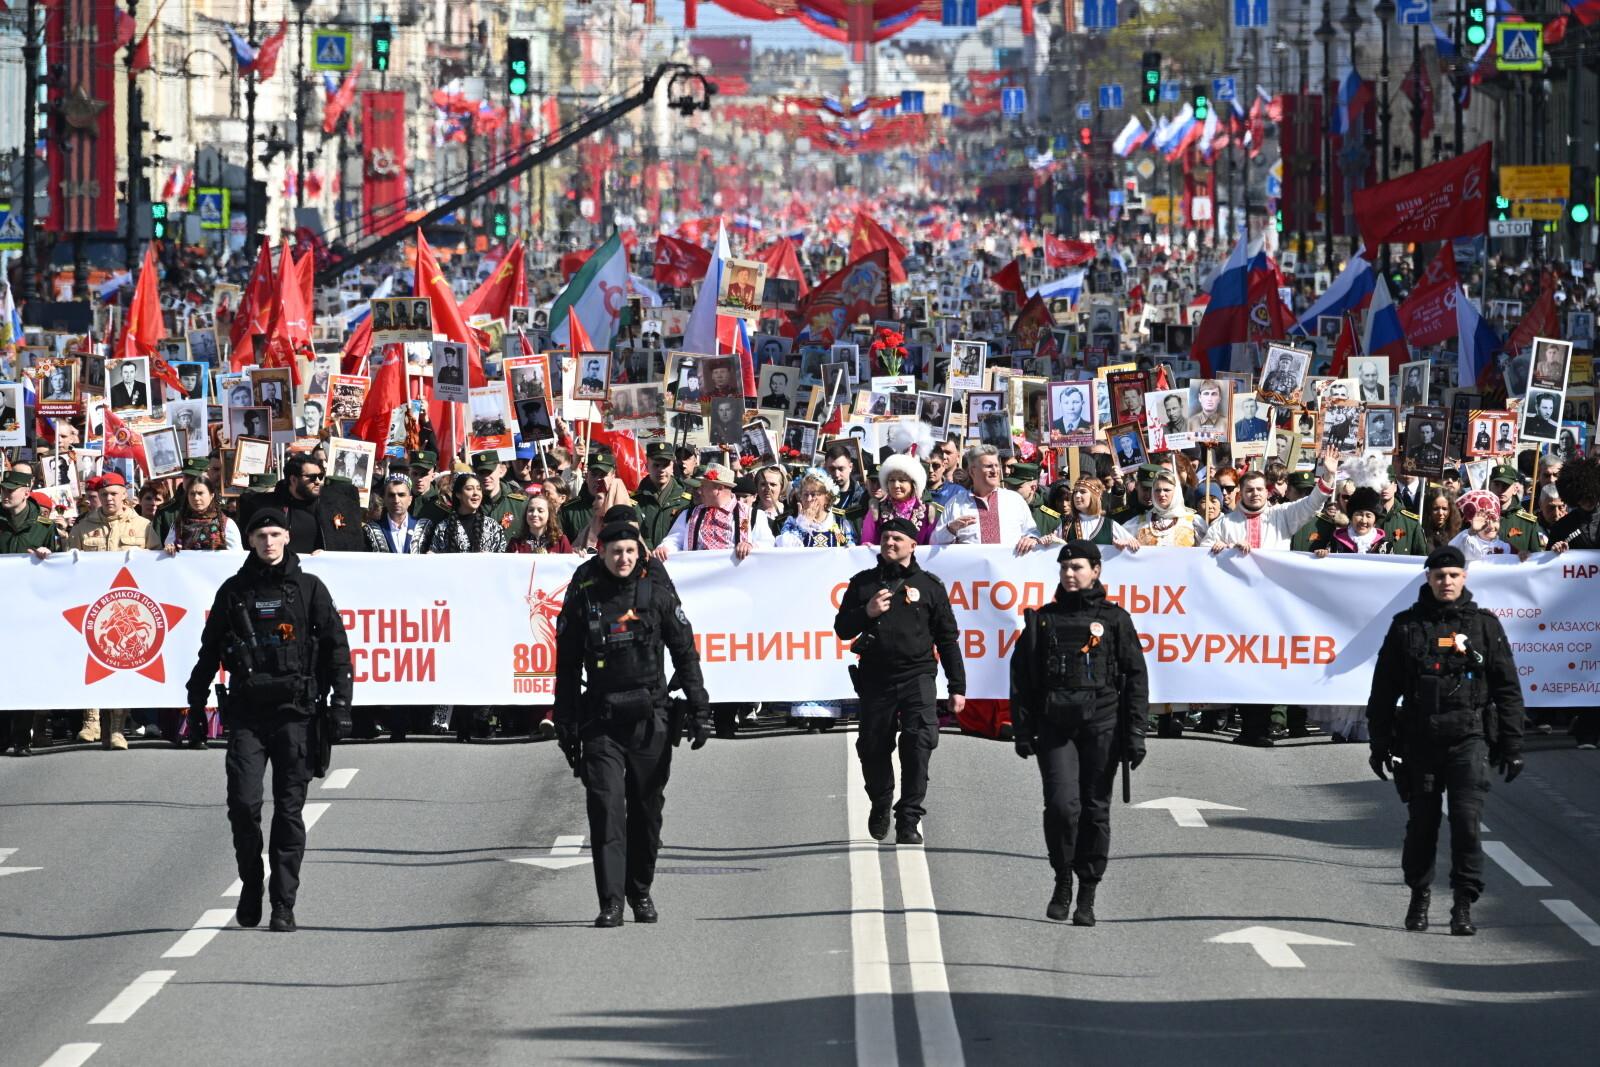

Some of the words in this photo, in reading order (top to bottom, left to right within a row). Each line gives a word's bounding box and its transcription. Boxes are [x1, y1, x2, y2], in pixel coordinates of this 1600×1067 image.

[1496, 223, 1531, 234] СТОП
[1563, 565, 1600, 578] НАР
[946, 581, 1187, 616] АГОДНЫХ
[89, 604, 101, 619] ЛЕТ
[100, 591, 141, 606] ВЕЛИКОЙ
[141, 597, 164, 629] ПОБЕДЫ
[1516, 609, 1542, 618] ССР
[1137, 633, 1337, 670] РБУРЖЦЕВ
[1511, 642, 1564, 652] ГИЗСКАЯ
[1567, 642, 1592, 652] ССР
[105, 658, 120, 667] 1941
[131, 657, 146, 667] 1945
[351, 648, 436, 682] ССИИ
[513, 643, 548, 672] 80
[1518, 666, 1535, 676] СР
[513, 678, 557, 695] ПОБЕ
